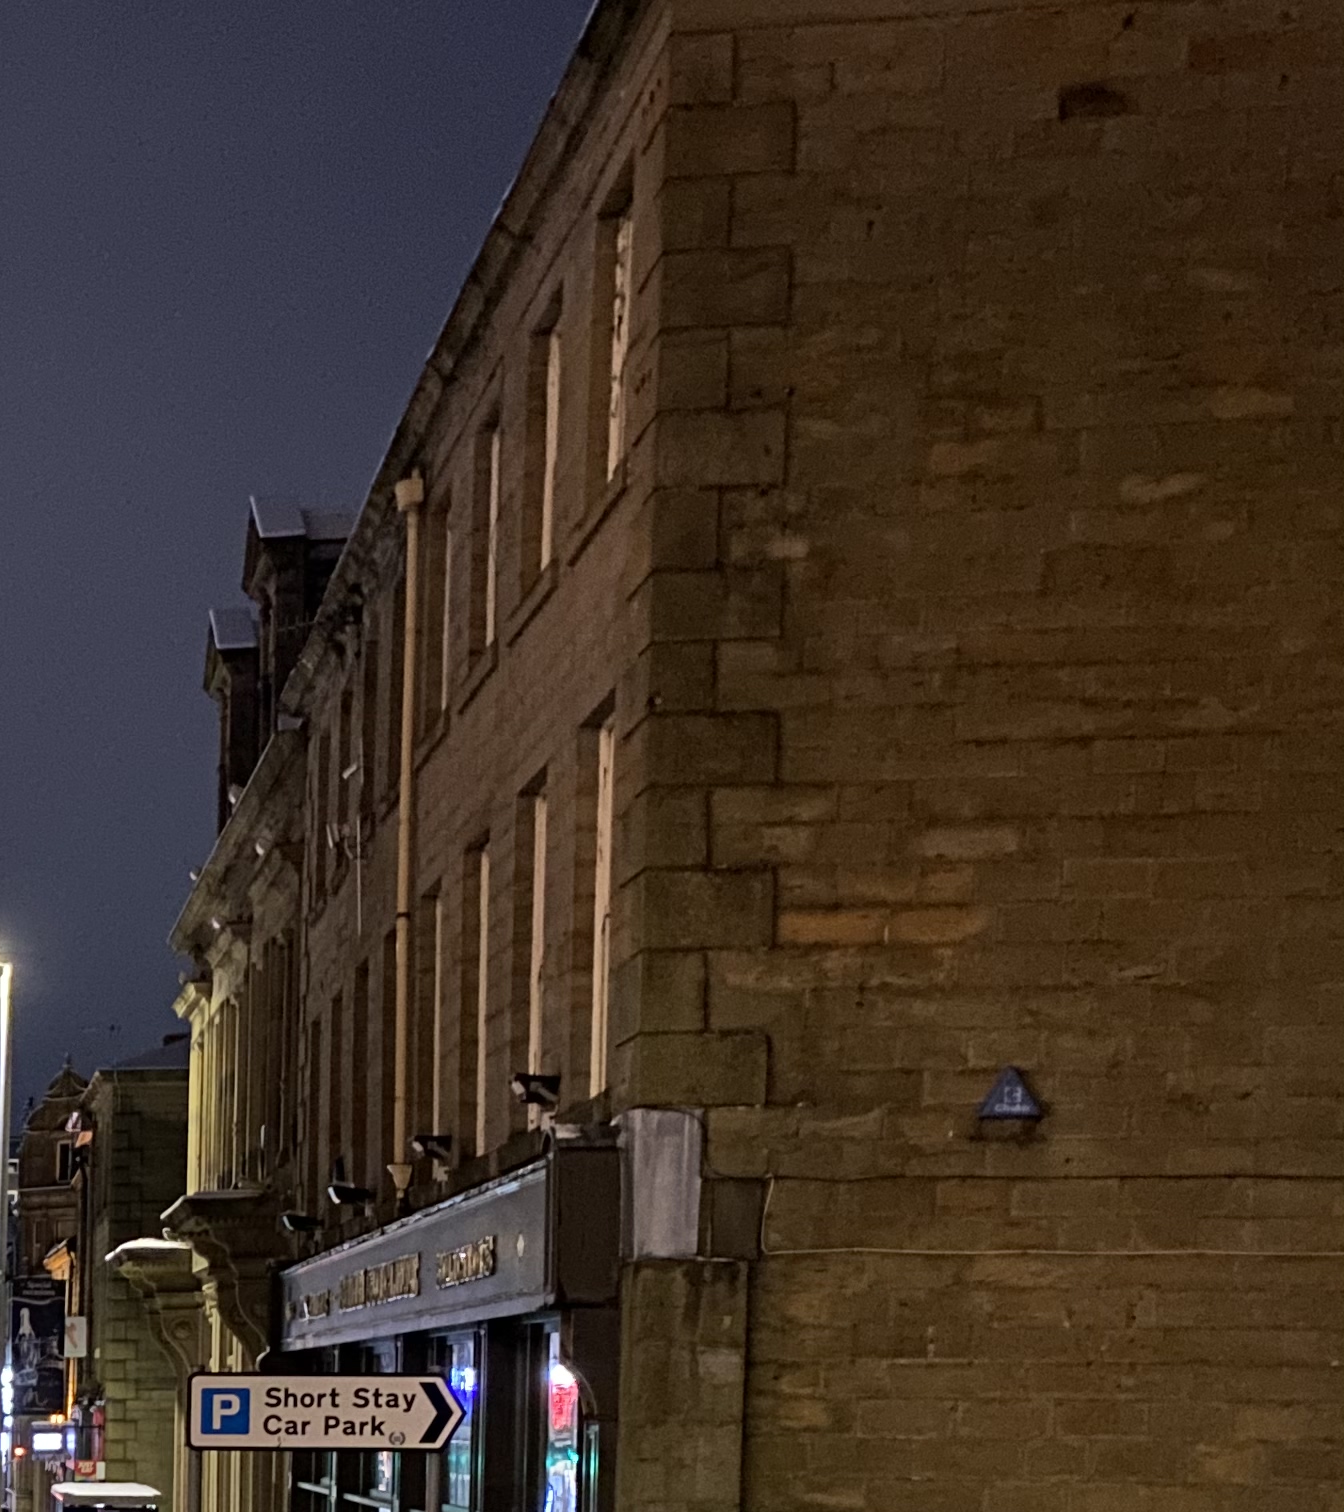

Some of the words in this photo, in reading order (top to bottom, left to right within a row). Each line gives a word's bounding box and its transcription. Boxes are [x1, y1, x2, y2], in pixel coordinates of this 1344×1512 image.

[264, 1387, 340, 1409] Short
[352, 1387, 417, 1412] Stay
[263, 1414, 311, 1436] Car
[324, 1415, 386, 1436] Park
